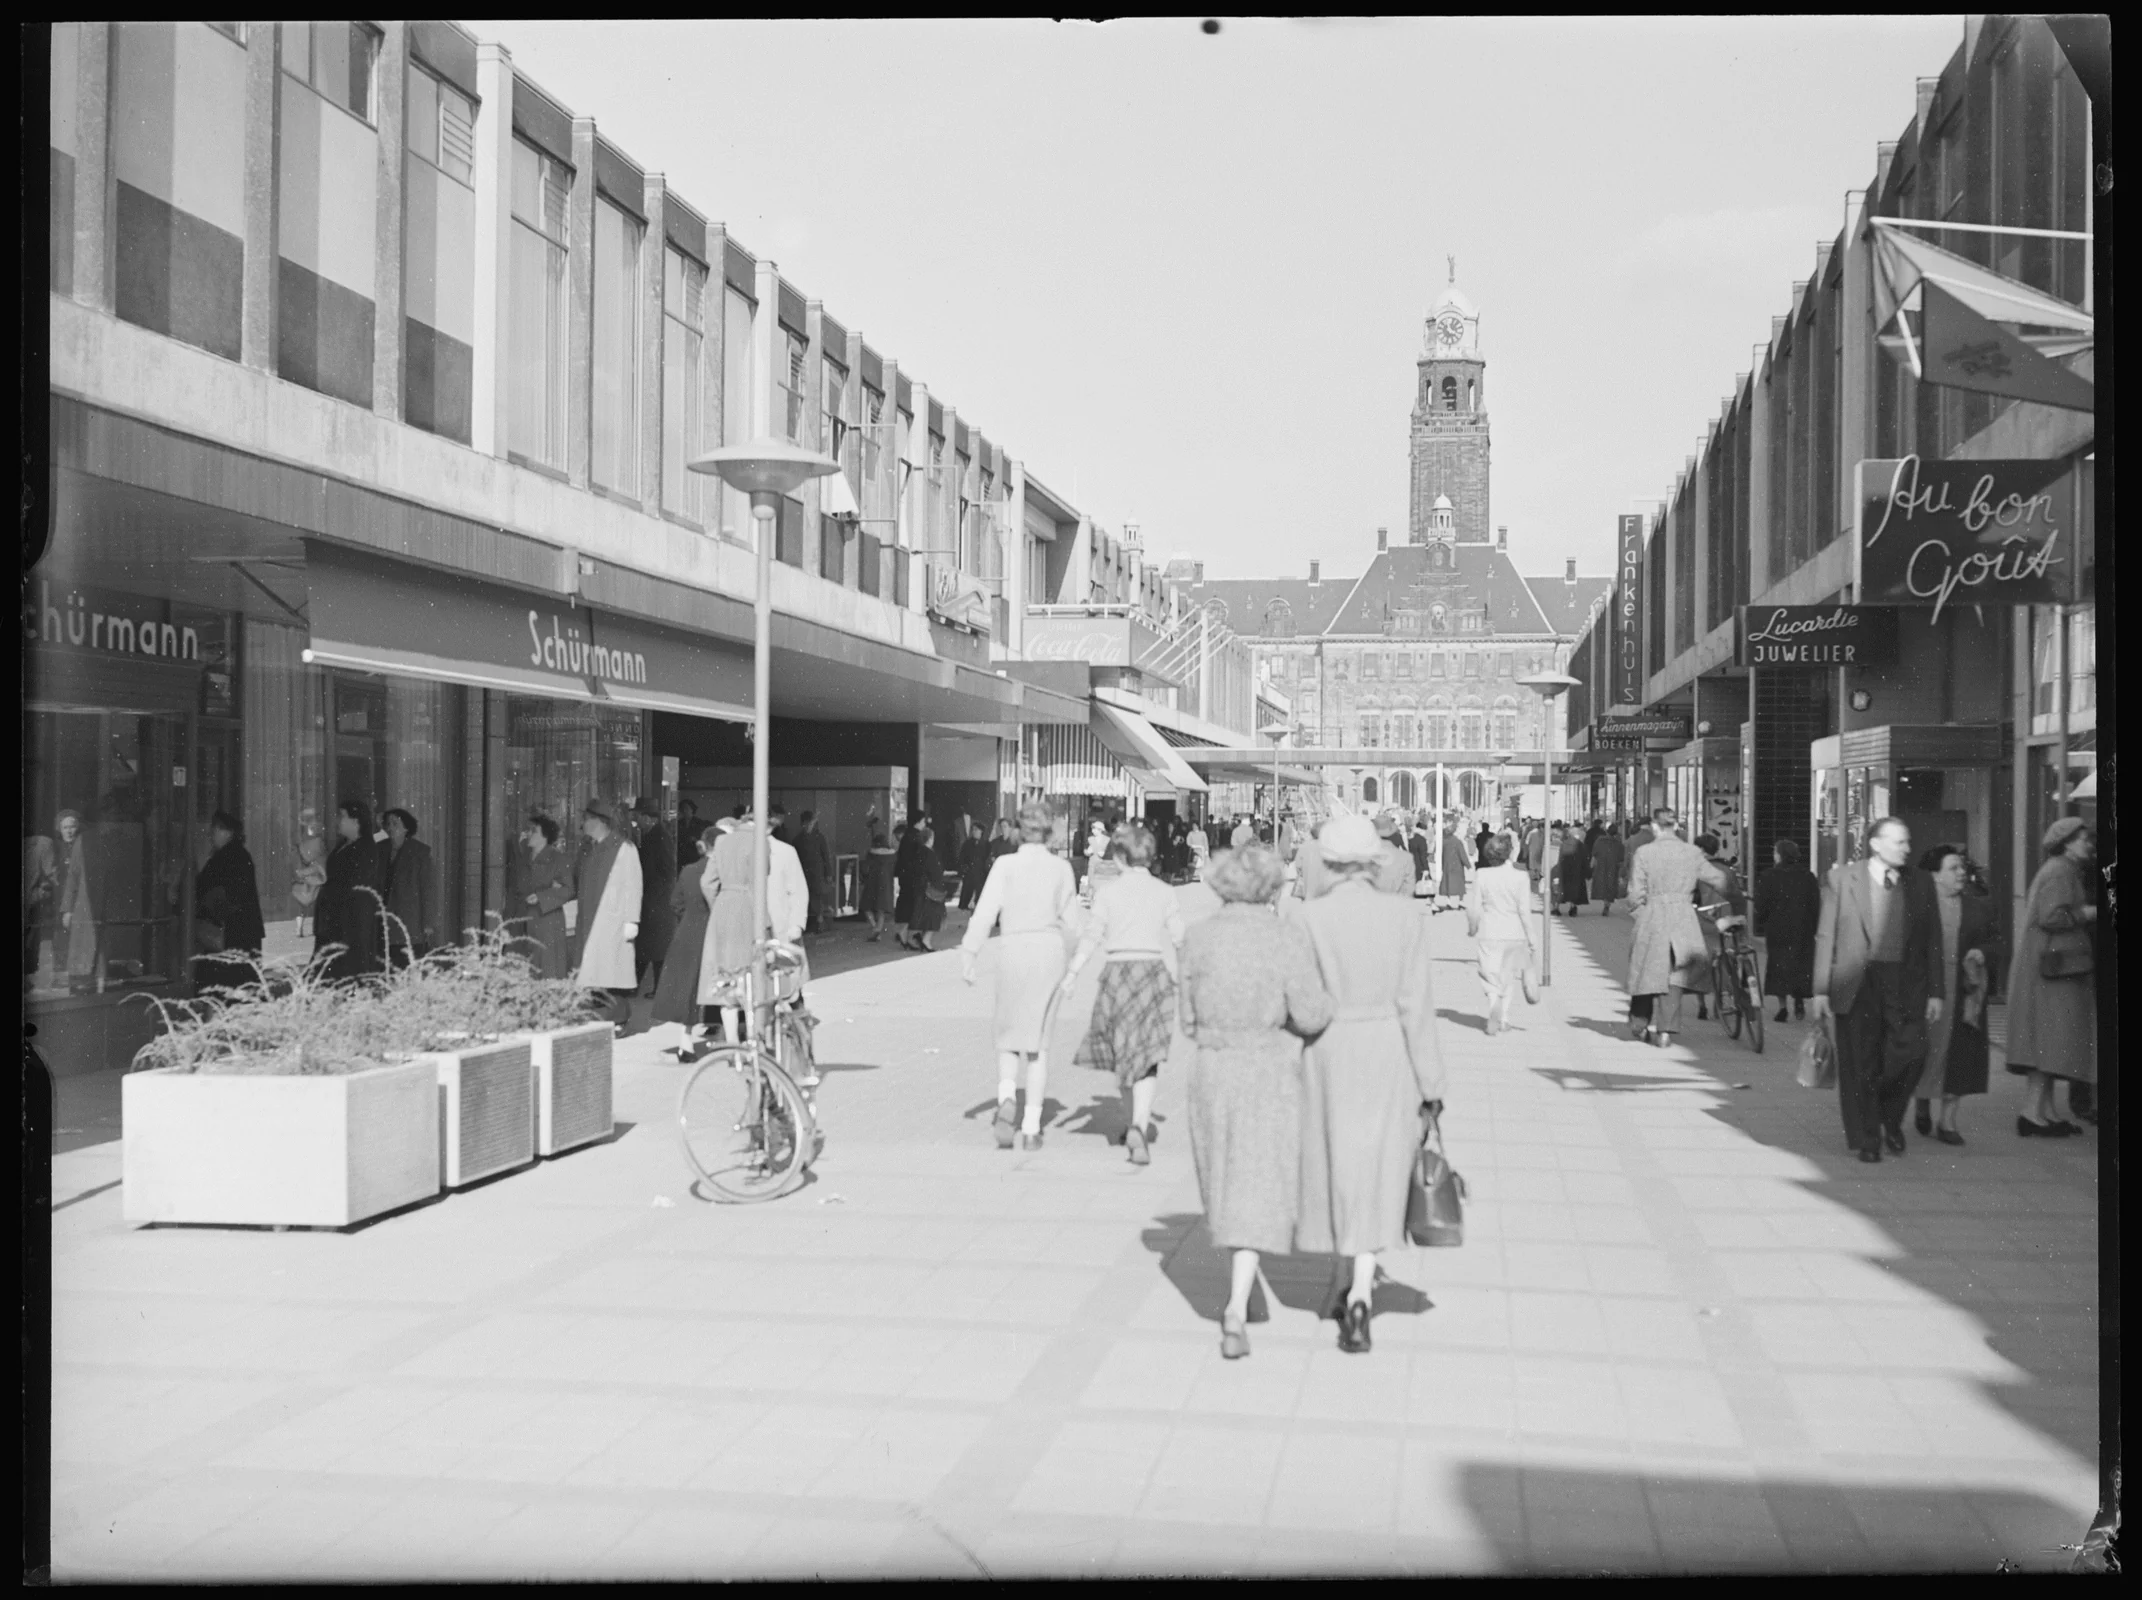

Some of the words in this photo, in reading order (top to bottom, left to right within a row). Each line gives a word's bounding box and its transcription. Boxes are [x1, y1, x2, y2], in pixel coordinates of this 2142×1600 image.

[1866, 454, 1953, 548] Au
[1958, 474, 2055, 531] bon
[1906, 529, 2064, 625] Goût
[1623, 516, 1637, 702] Frankenhuis
[1748, 608, 1858, 641] Lucardie
[529, 610, 646, 684] Schürmann
[1754, 645, 1855, 662] JUWELIER
[1594, 739, 1640, 750] BOEKEN
[1600, 716, 1685, 734] Linnenmagazijn
